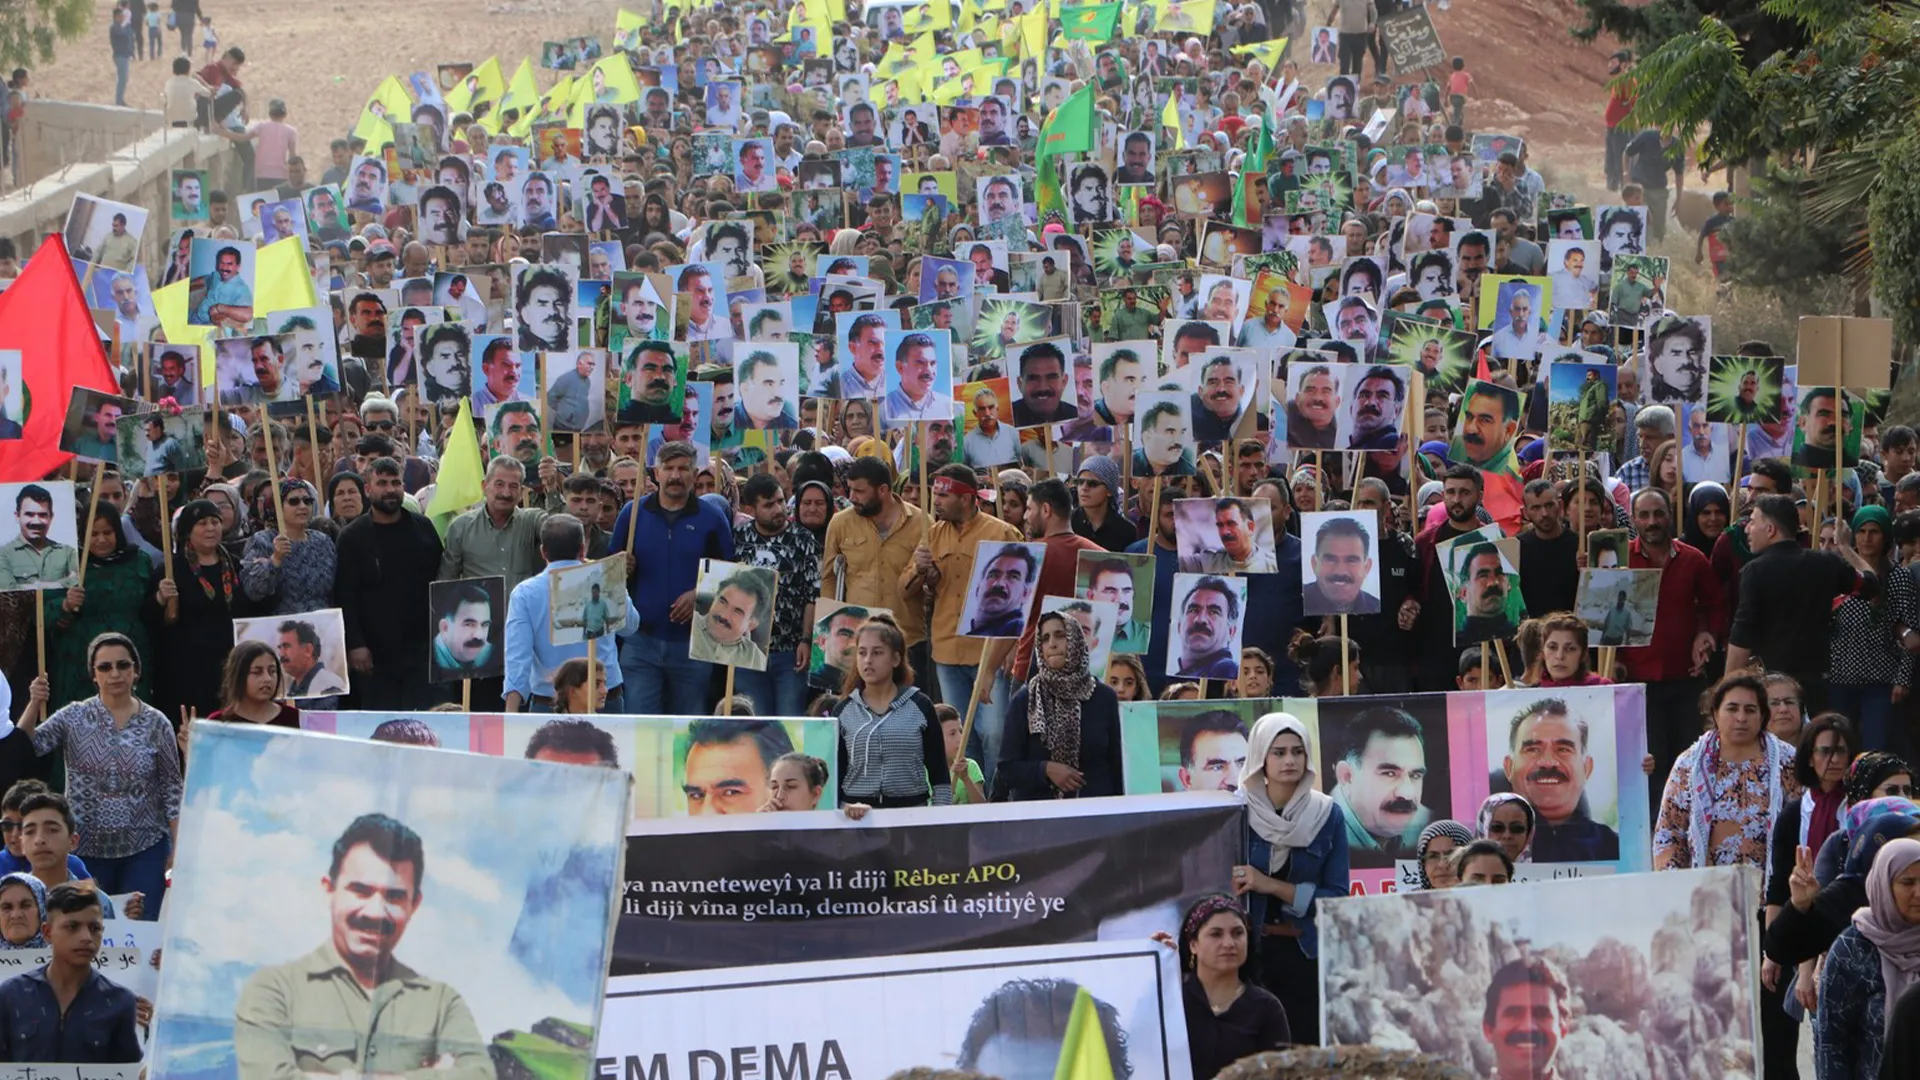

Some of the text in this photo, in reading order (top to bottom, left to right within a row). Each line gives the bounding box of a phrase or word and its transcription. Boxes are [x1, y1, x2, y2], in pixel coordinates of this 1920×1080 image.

[622, 863, 1021, 896] ya navneteweyî ya li dijî Rêber APO,
[625, 891, 1066, 922] li dijî vîna gelan, demokrasî û aşitiyê ye
[688, 1039, 853, 1080] DEMA
